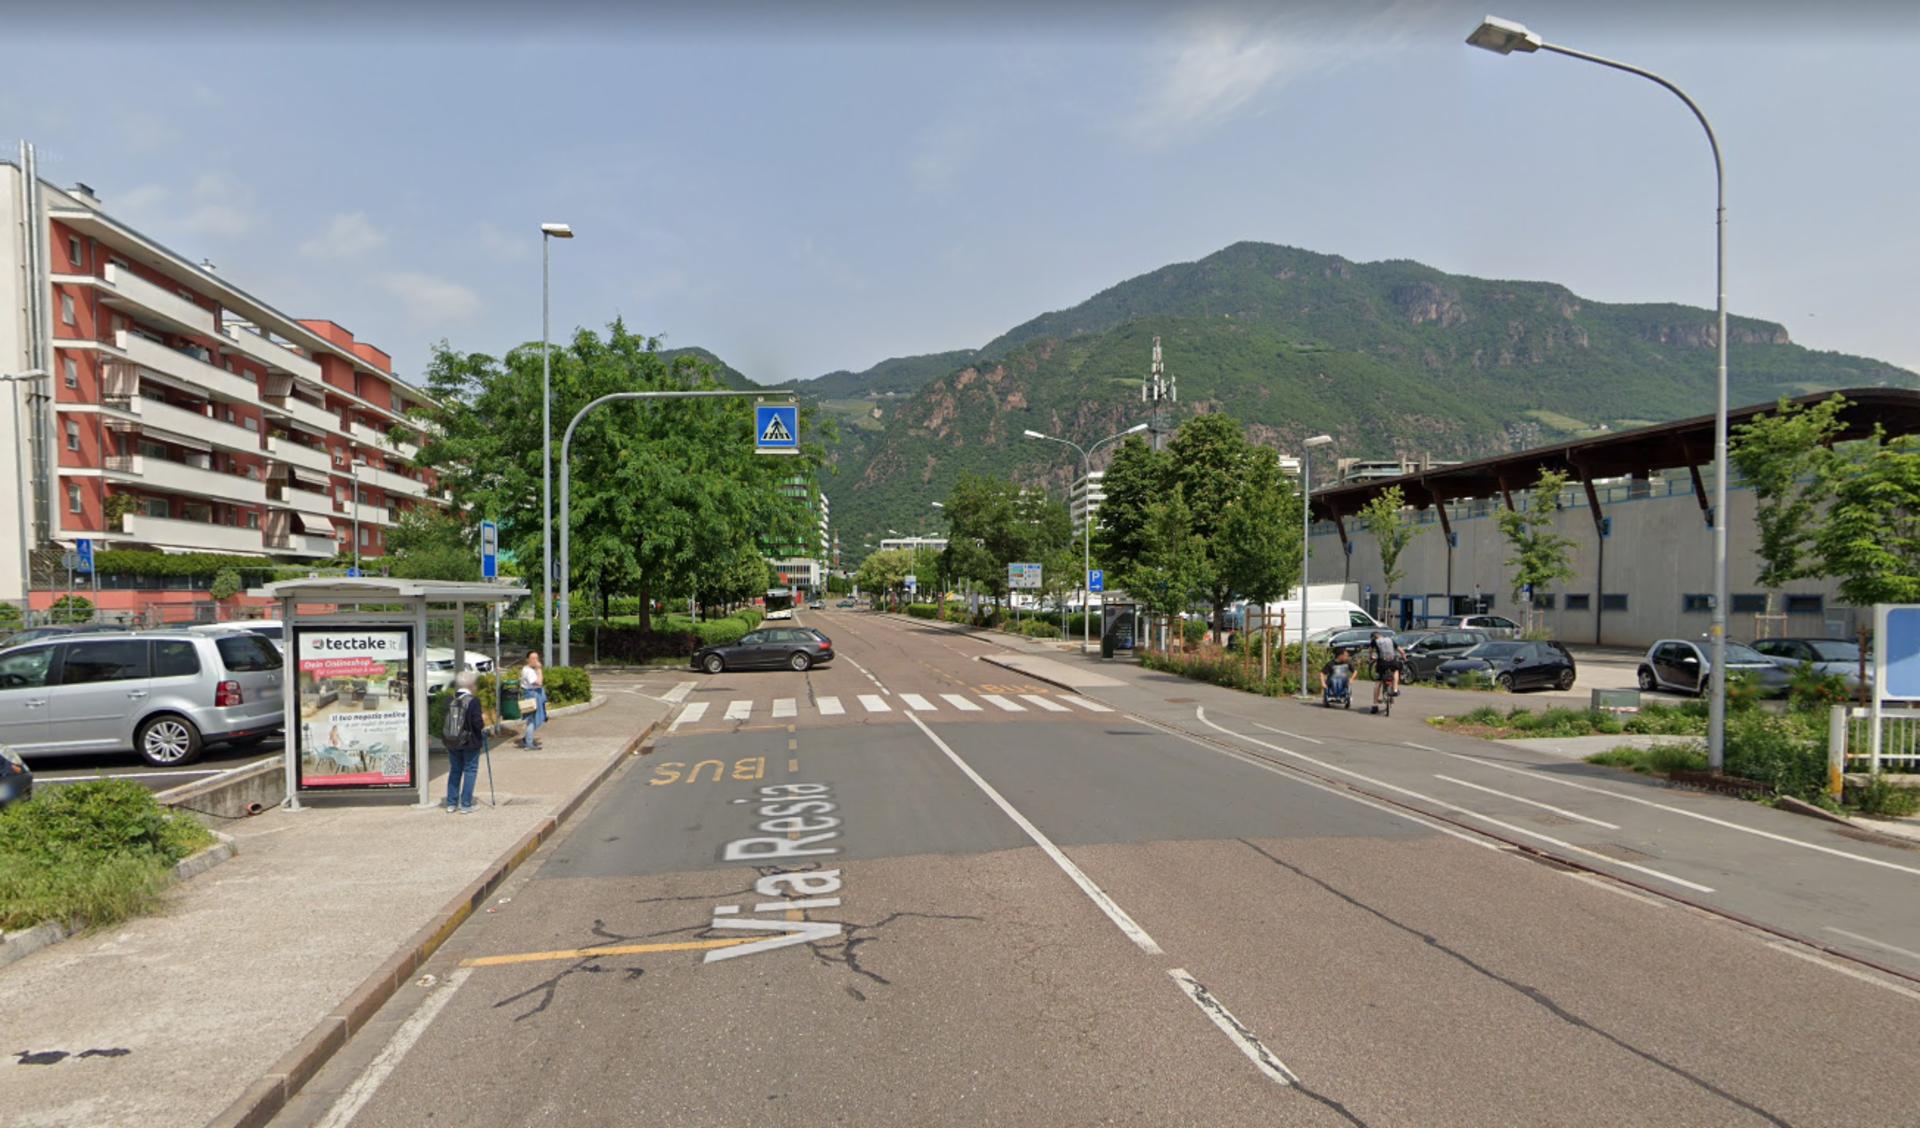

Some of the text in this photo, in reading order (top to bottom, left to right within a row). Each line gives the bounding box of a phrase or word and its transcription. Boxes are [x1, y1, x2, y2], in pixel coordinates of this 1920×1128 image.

[1091, 571, 1101, 583] P
[324, 657, 370, 669] Onlineshop
[648, 756, 766, 786] BUS
